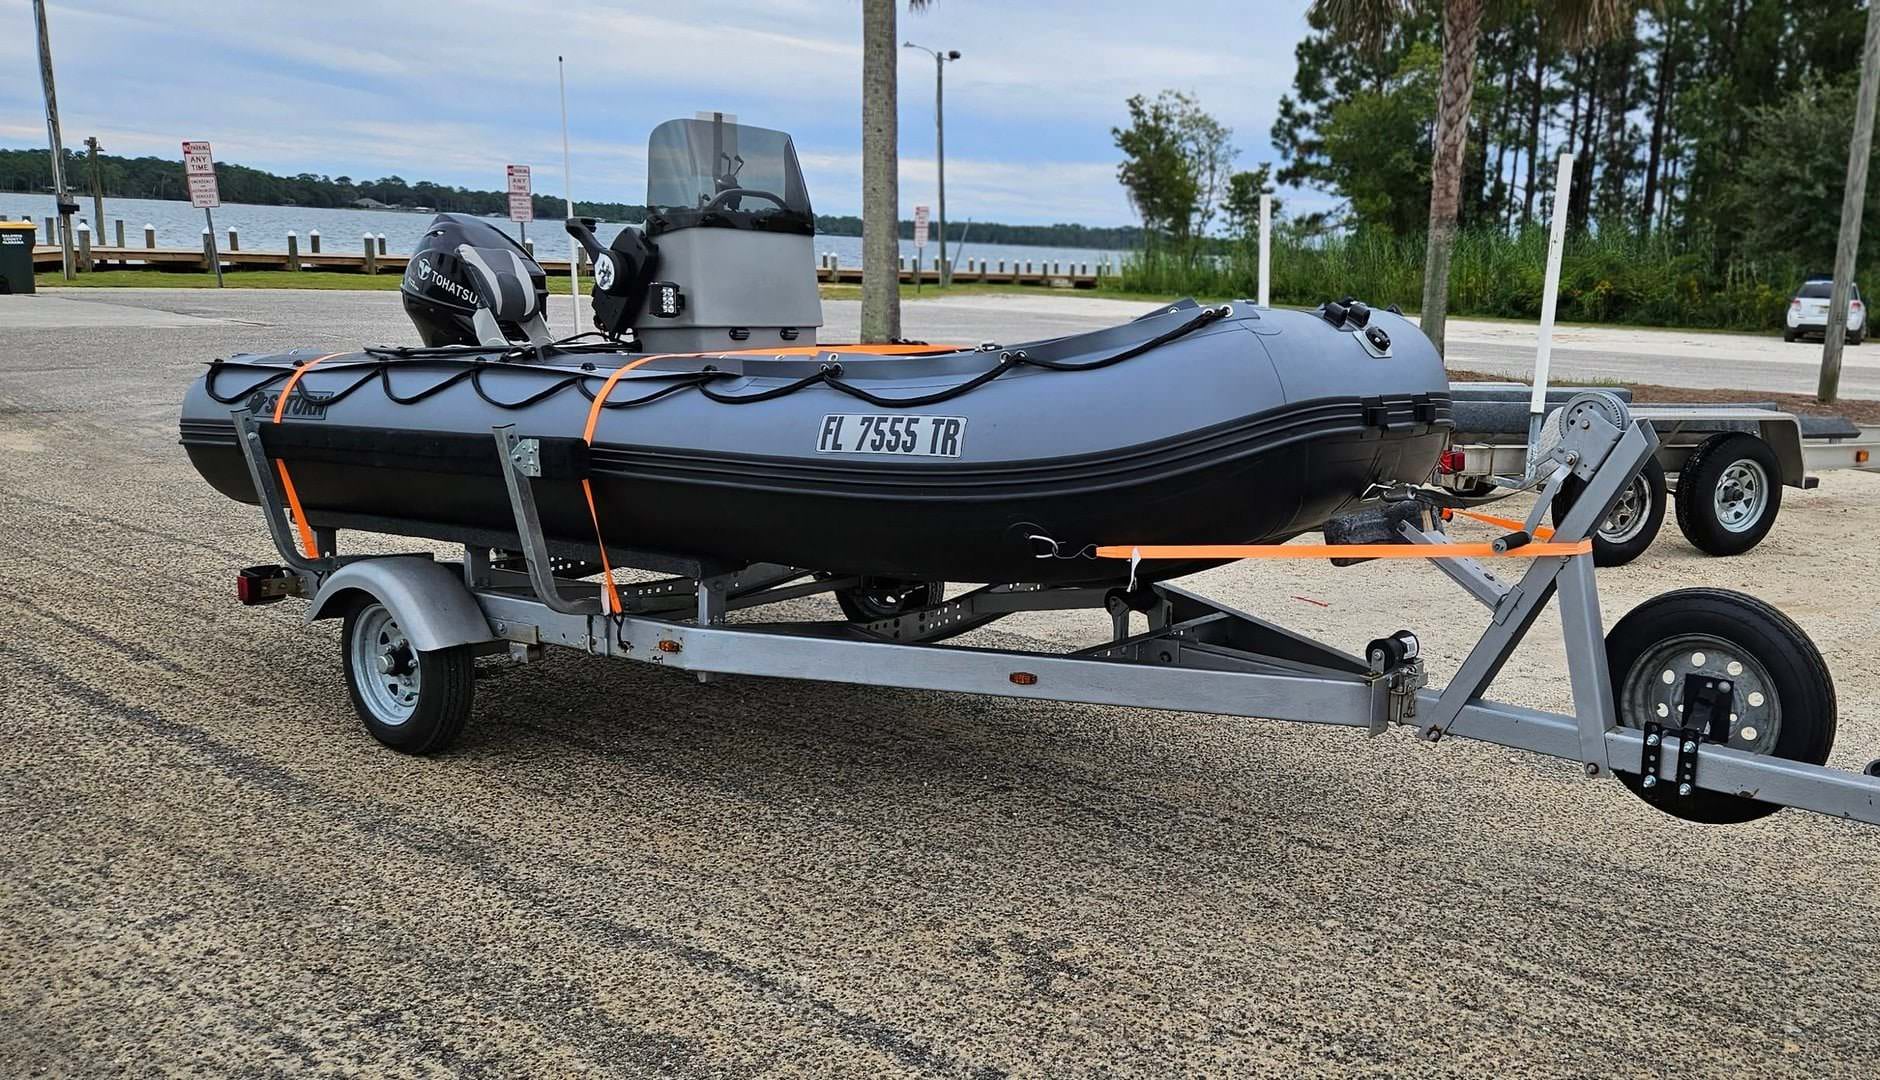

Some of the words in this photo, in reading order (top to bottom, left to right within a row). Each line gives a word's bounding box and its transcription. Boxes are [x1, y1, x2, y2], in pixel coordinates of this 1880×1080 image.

[431, 270, 479, 304] TOHATSU
[264, 393, 331, 416] STURN
[820, 416, 844, 451] FL
[855, 416, 920, 453] 7555
[930, 418, 961, 455] TR
